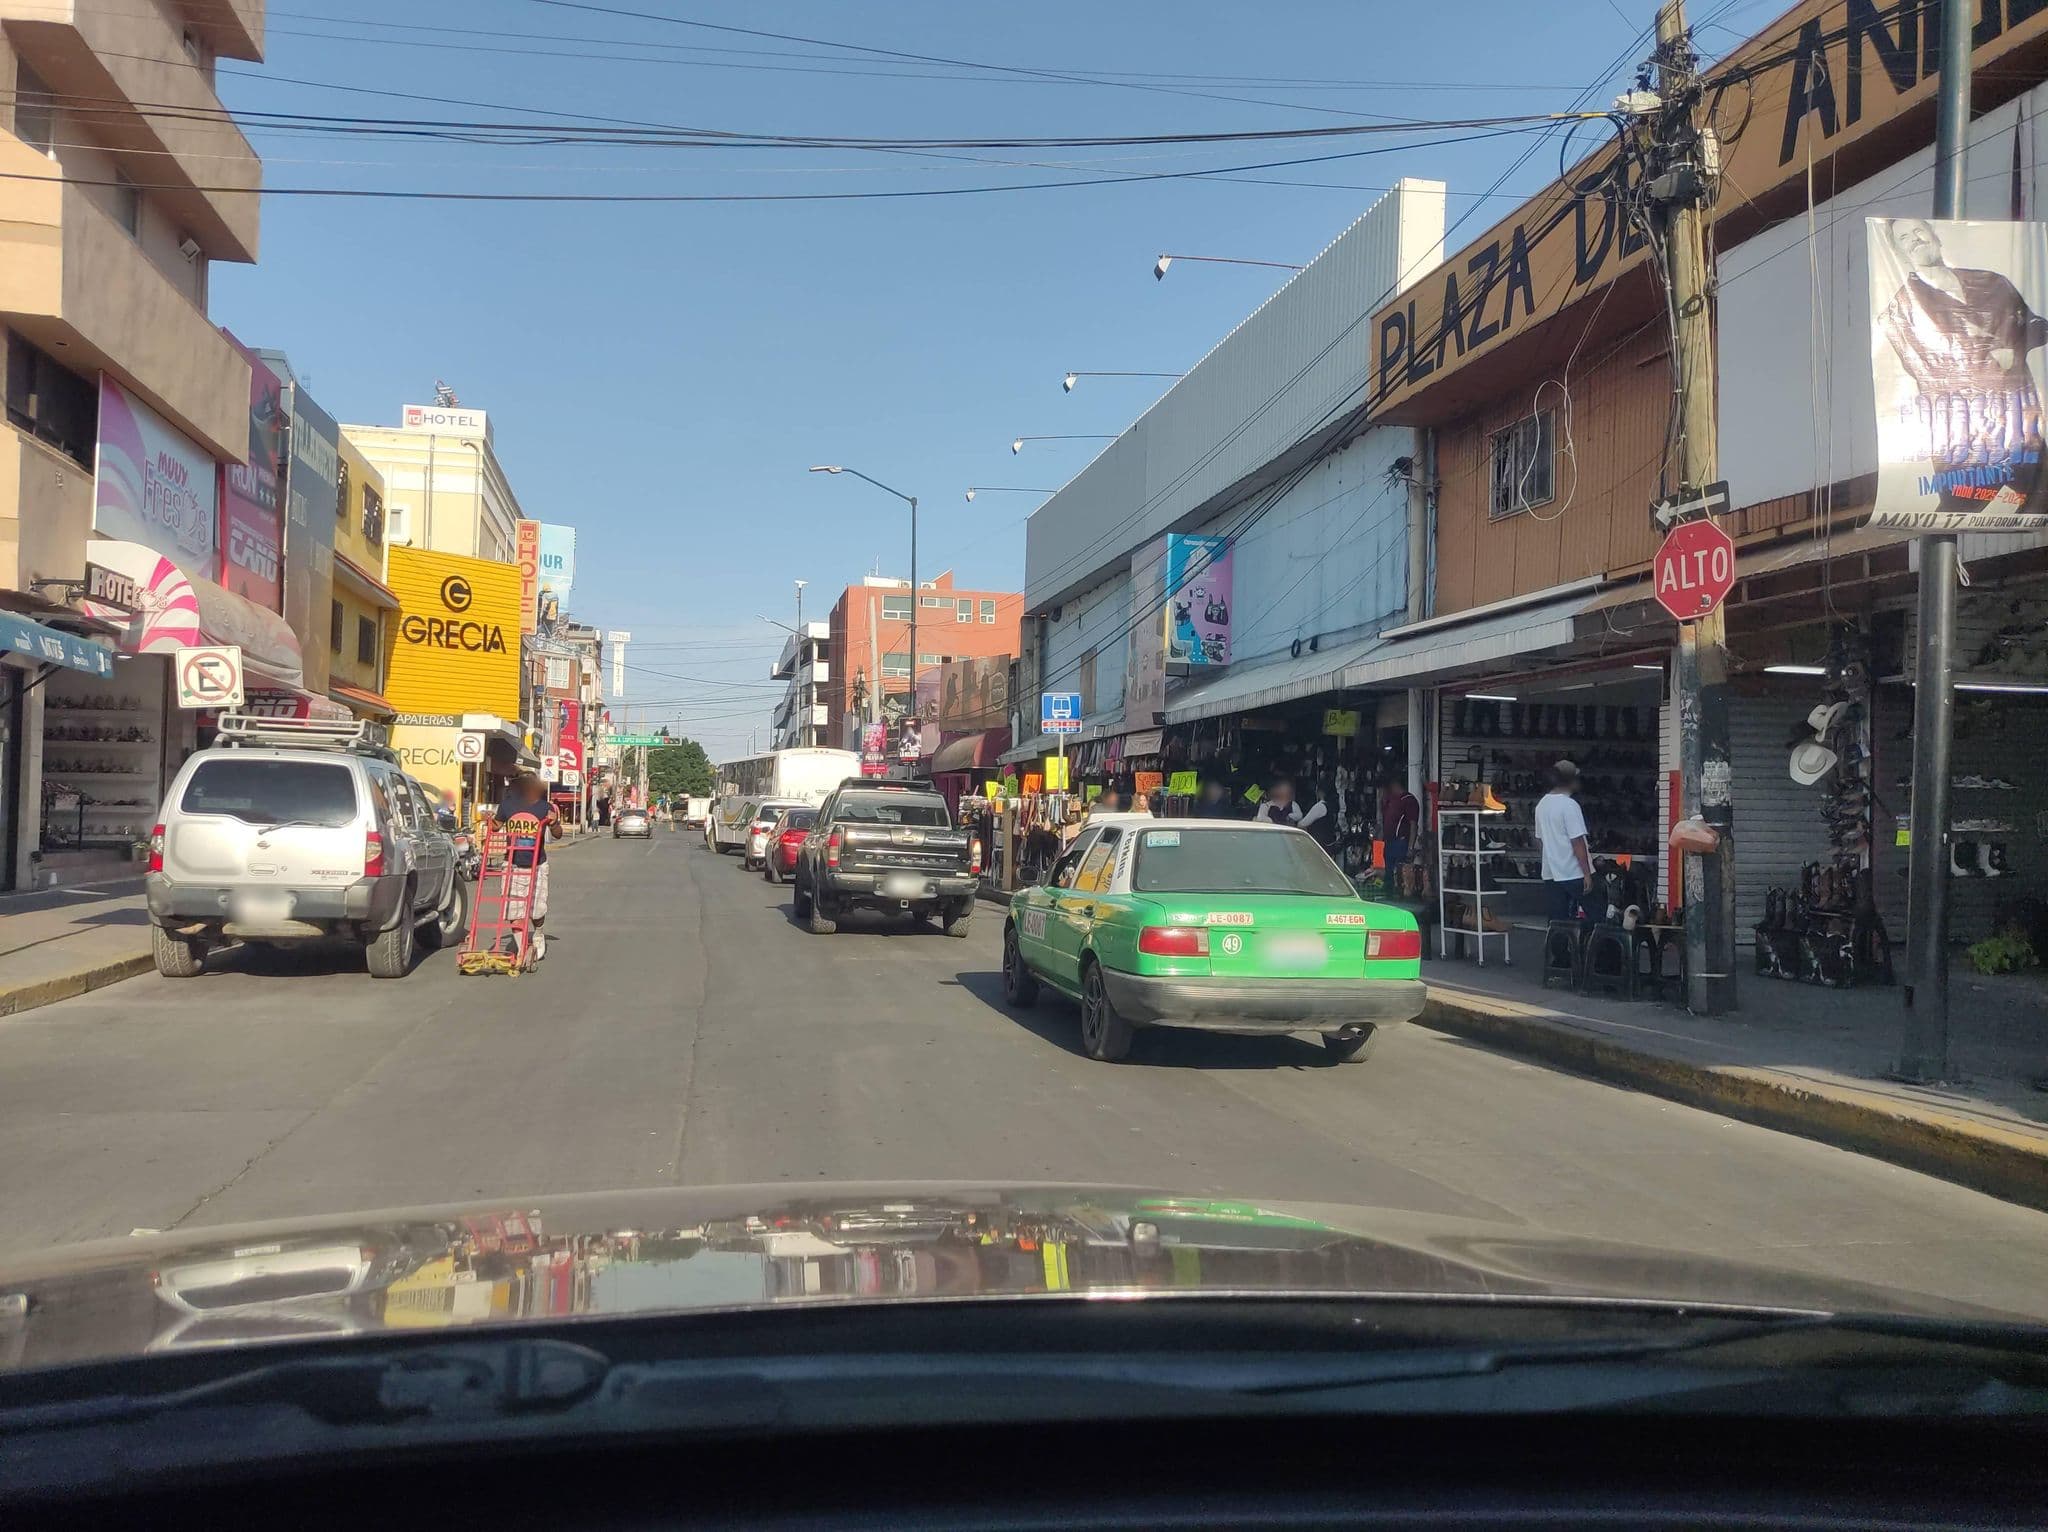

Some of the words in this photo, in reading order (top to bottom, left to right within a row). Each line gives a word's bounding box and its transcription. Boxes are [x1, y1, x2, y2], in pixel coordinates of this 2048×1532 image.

[1380, 223, 1535, 400] PLAZA
[423, 413, 479, 427] HOTEL
[1917, 463, 2015, 498] IMPORTANTE
[1876, 512, 1937, 529] MAYO
[1944, 513, 1968, 529] 17
[1967, 515, 2025, 529] POLIFORUM
[540, 552, 563, 570] UR
[1660, 546, 1728, 594] ALTO
[402, 615, 507, 655] GRECIA
[399, 747, 460, 767] RECIA
[1209, 914, 1251, 923] LE-0087
[1224, 937, 1239, 952] 49
